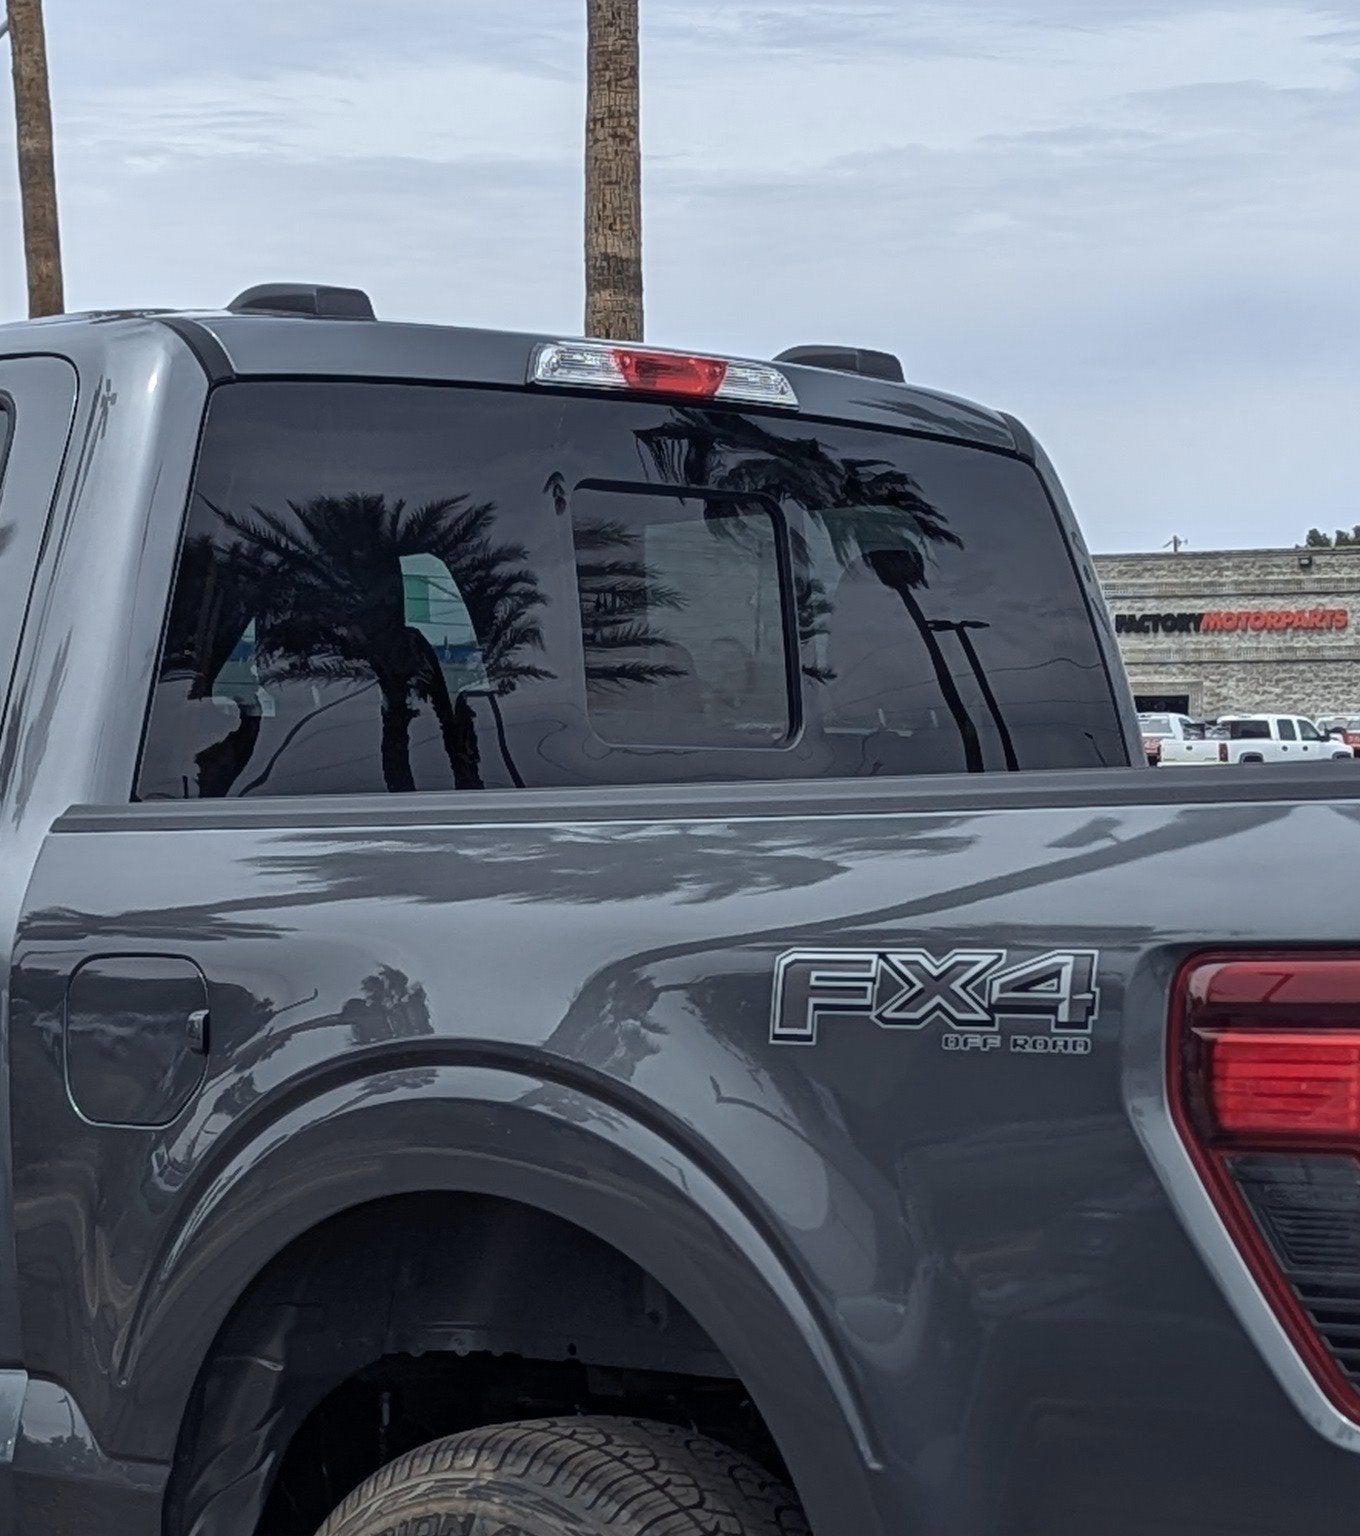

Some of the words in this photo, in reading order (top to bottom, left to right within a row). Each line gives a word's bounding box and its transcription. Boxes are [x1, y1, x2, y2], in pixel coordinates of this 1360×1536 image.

[769, 947, 1099, 1045] FX4
[942, 1034, 1001, 1051] OFF
[1010, 1035, 1090, 1054] ROAD
